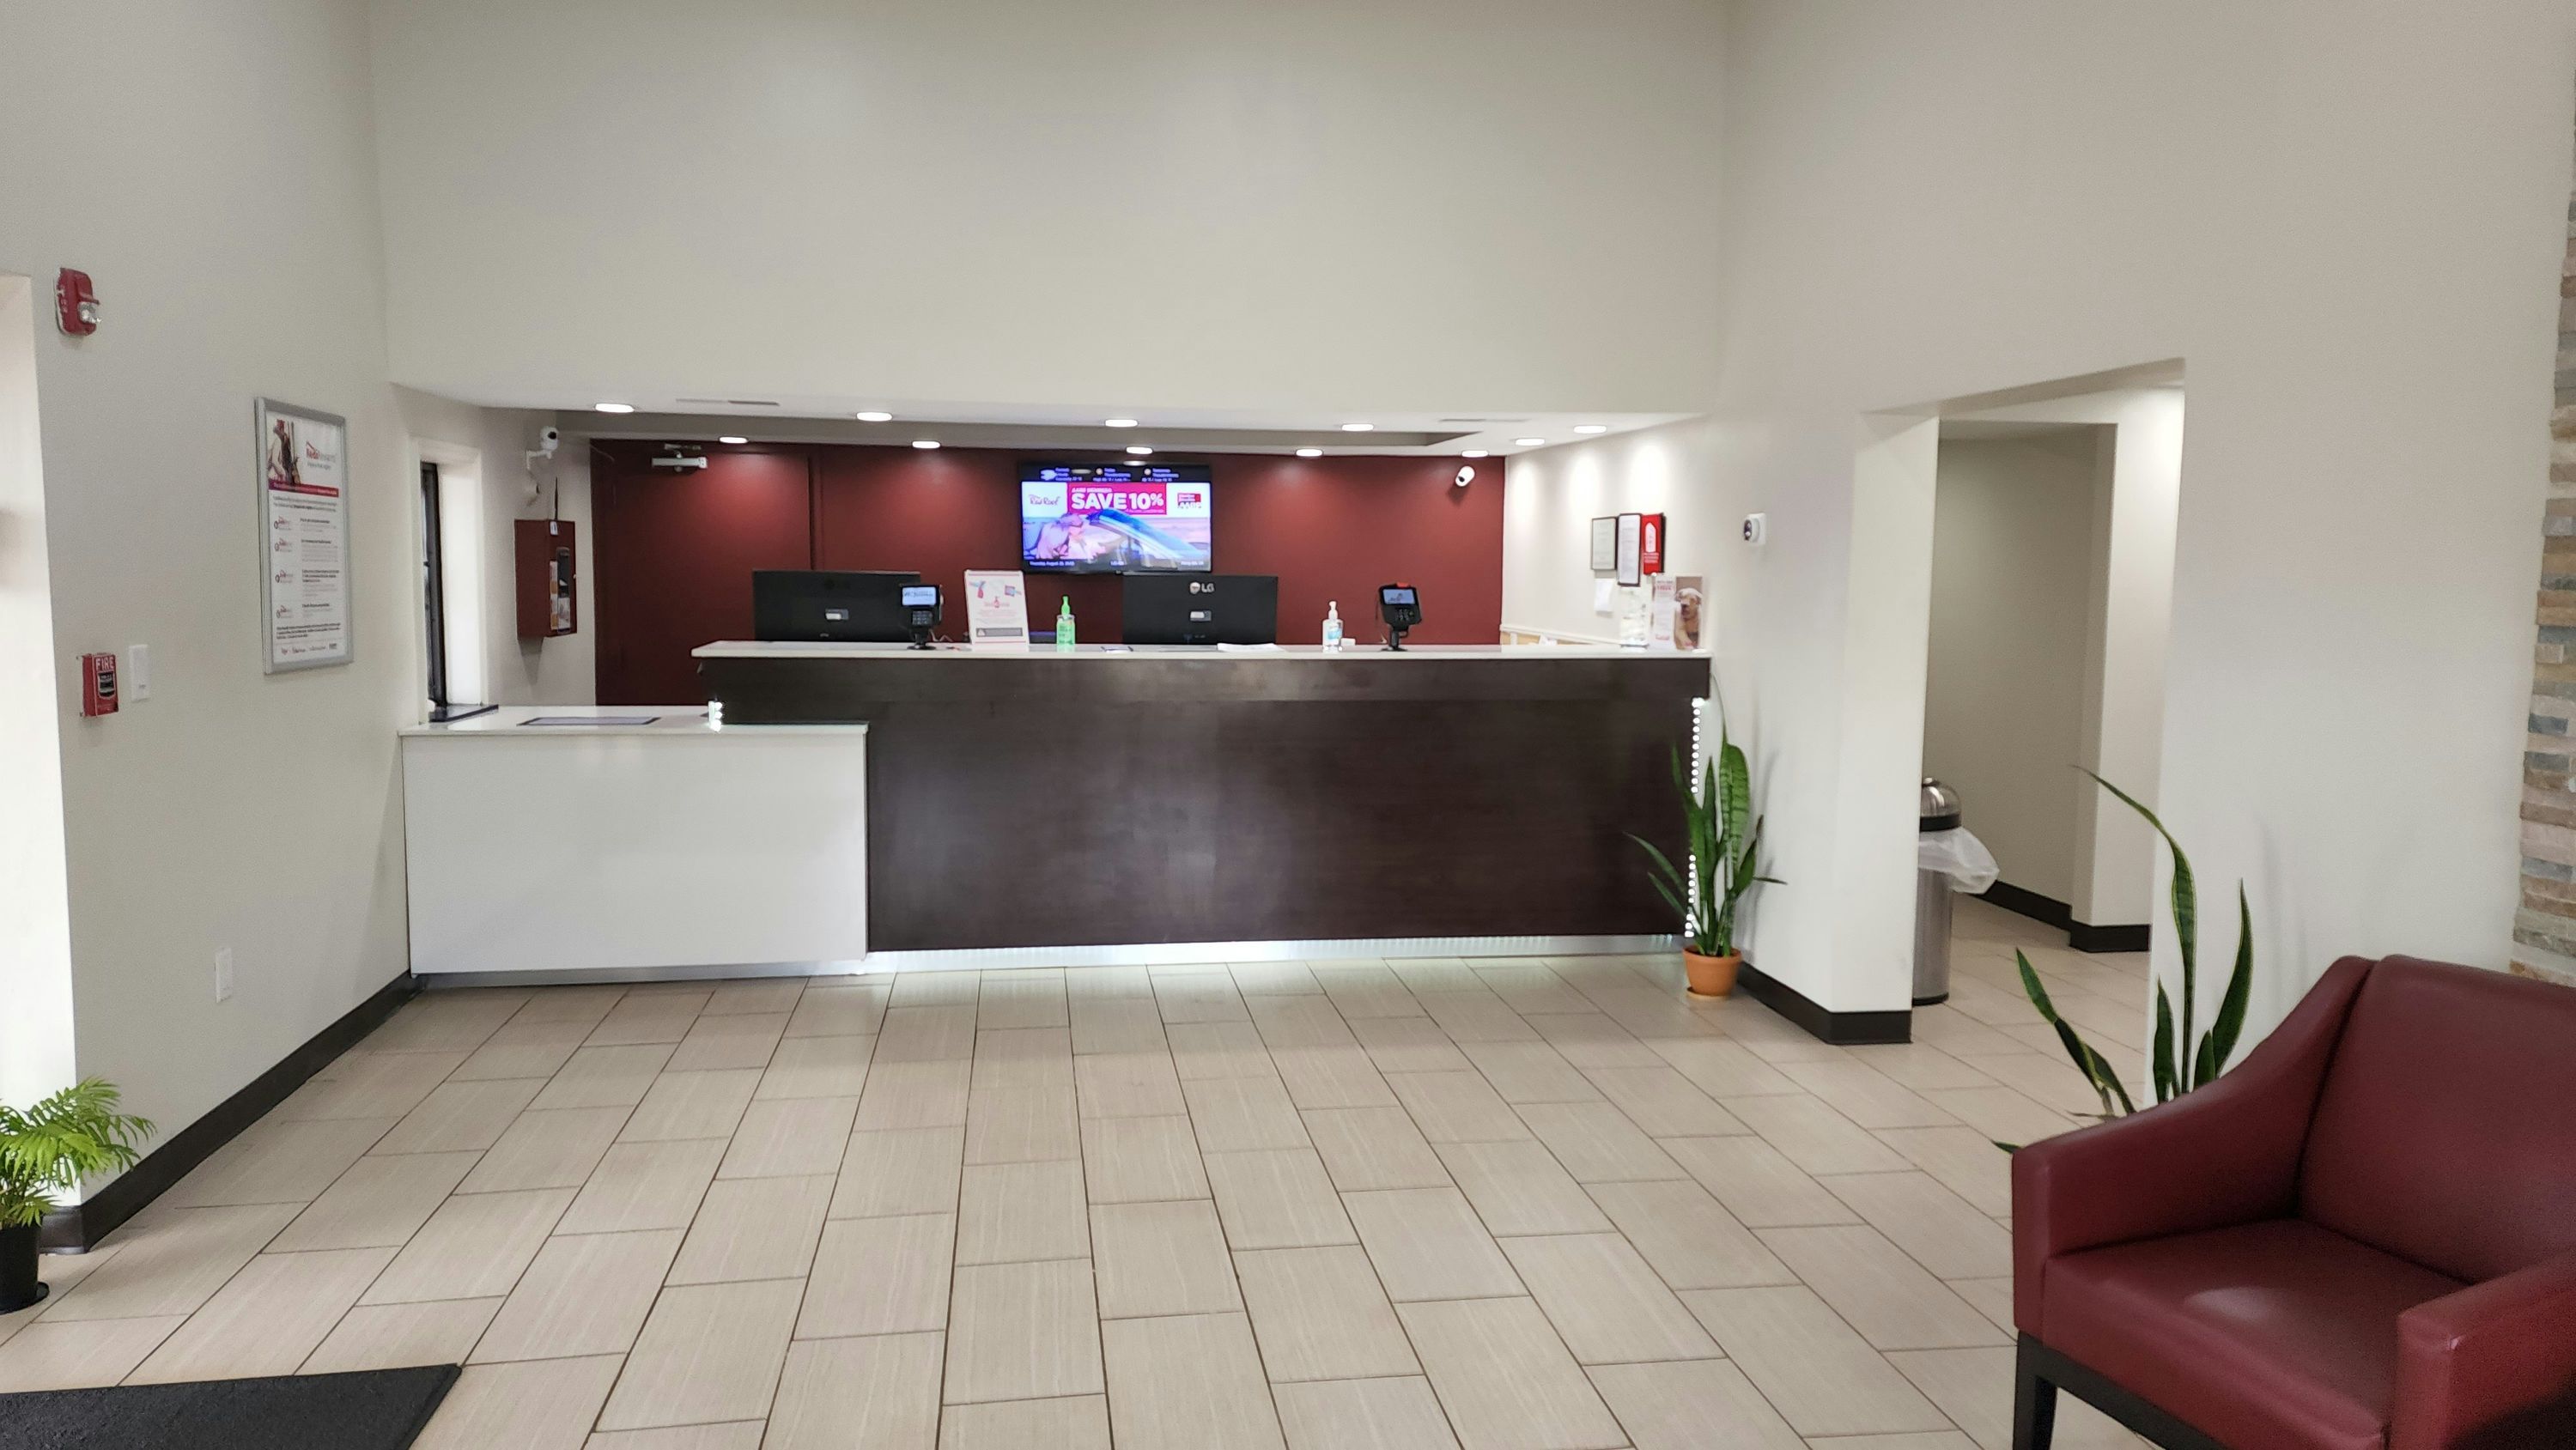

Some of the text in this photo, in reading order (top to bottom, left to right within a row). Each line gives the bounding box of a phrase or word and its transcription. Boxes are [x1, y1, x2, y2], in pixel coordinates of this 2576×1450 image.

[1072, 493, 1127, 509] SAVE
[1128, 493, 1164, 509] 10%
[1201, 582, 1214, 593] LG
[95, 656, 115, 671] FIRE
